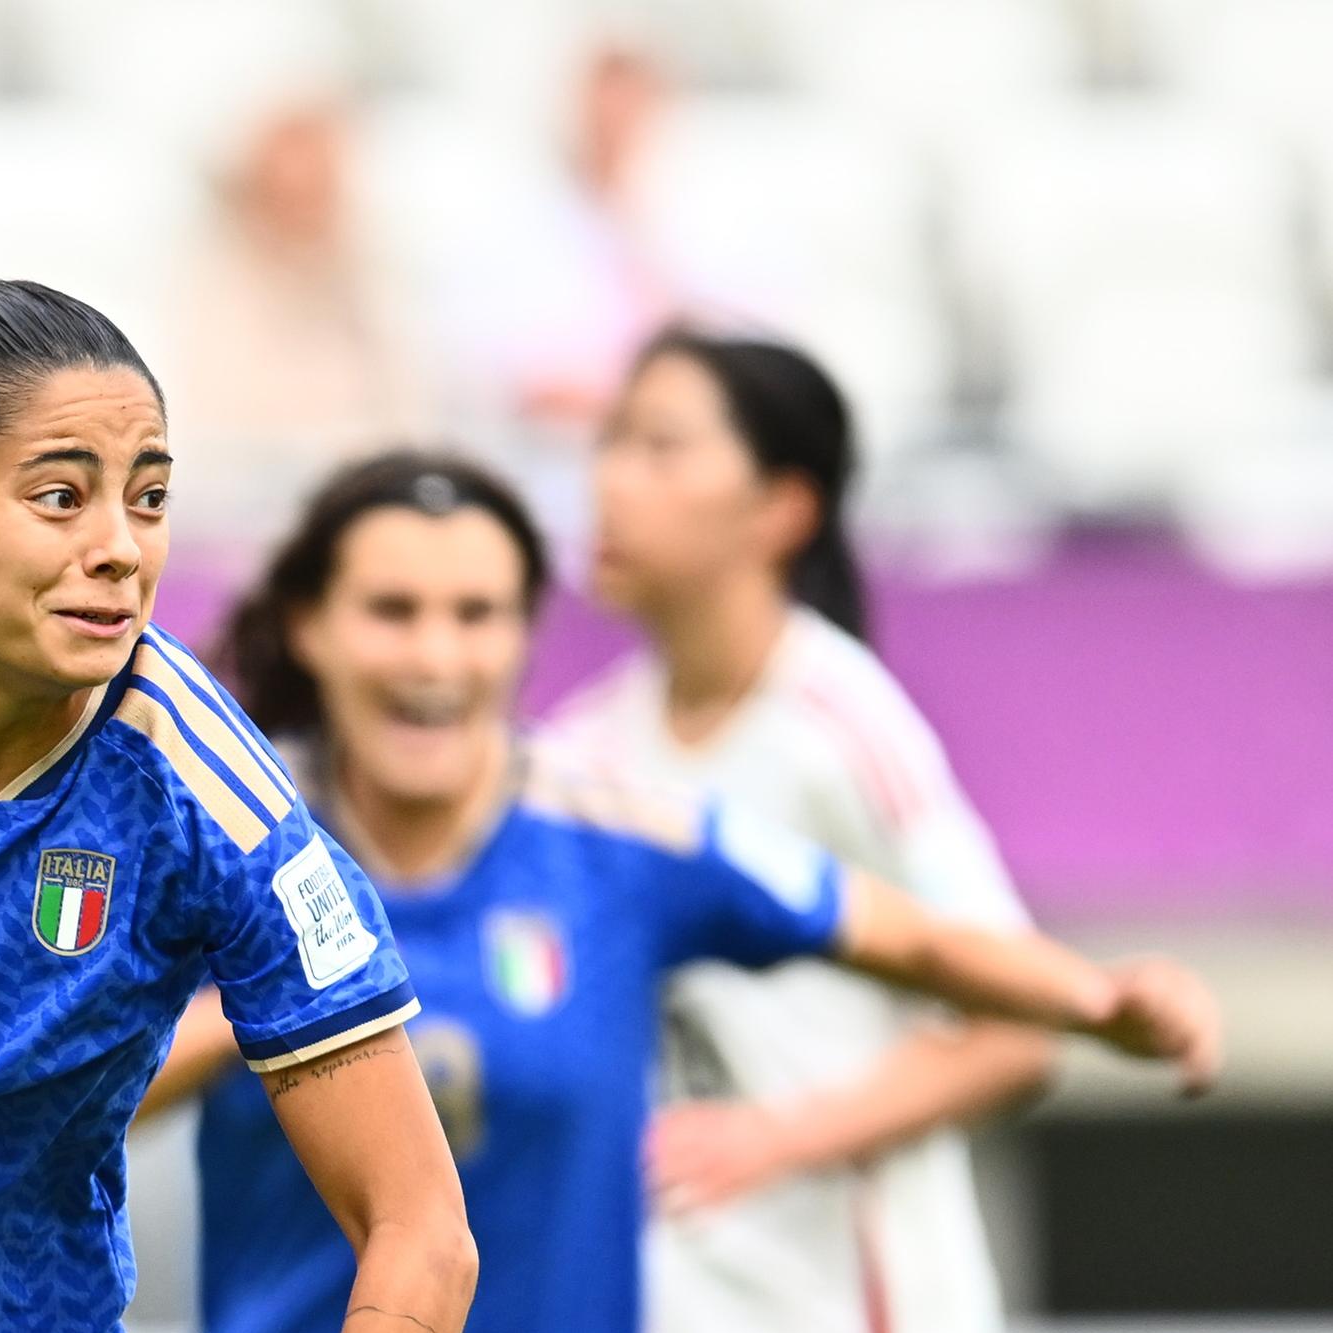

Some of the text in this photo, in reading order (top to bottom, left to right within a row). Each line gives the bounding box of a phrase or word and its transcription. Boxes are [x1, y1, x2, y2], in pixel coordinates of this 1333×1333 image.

[43, 855, 107, 881] ITALIA
[312, 923, 335, 947] the
[335, 932, 356, 951] FIFA
